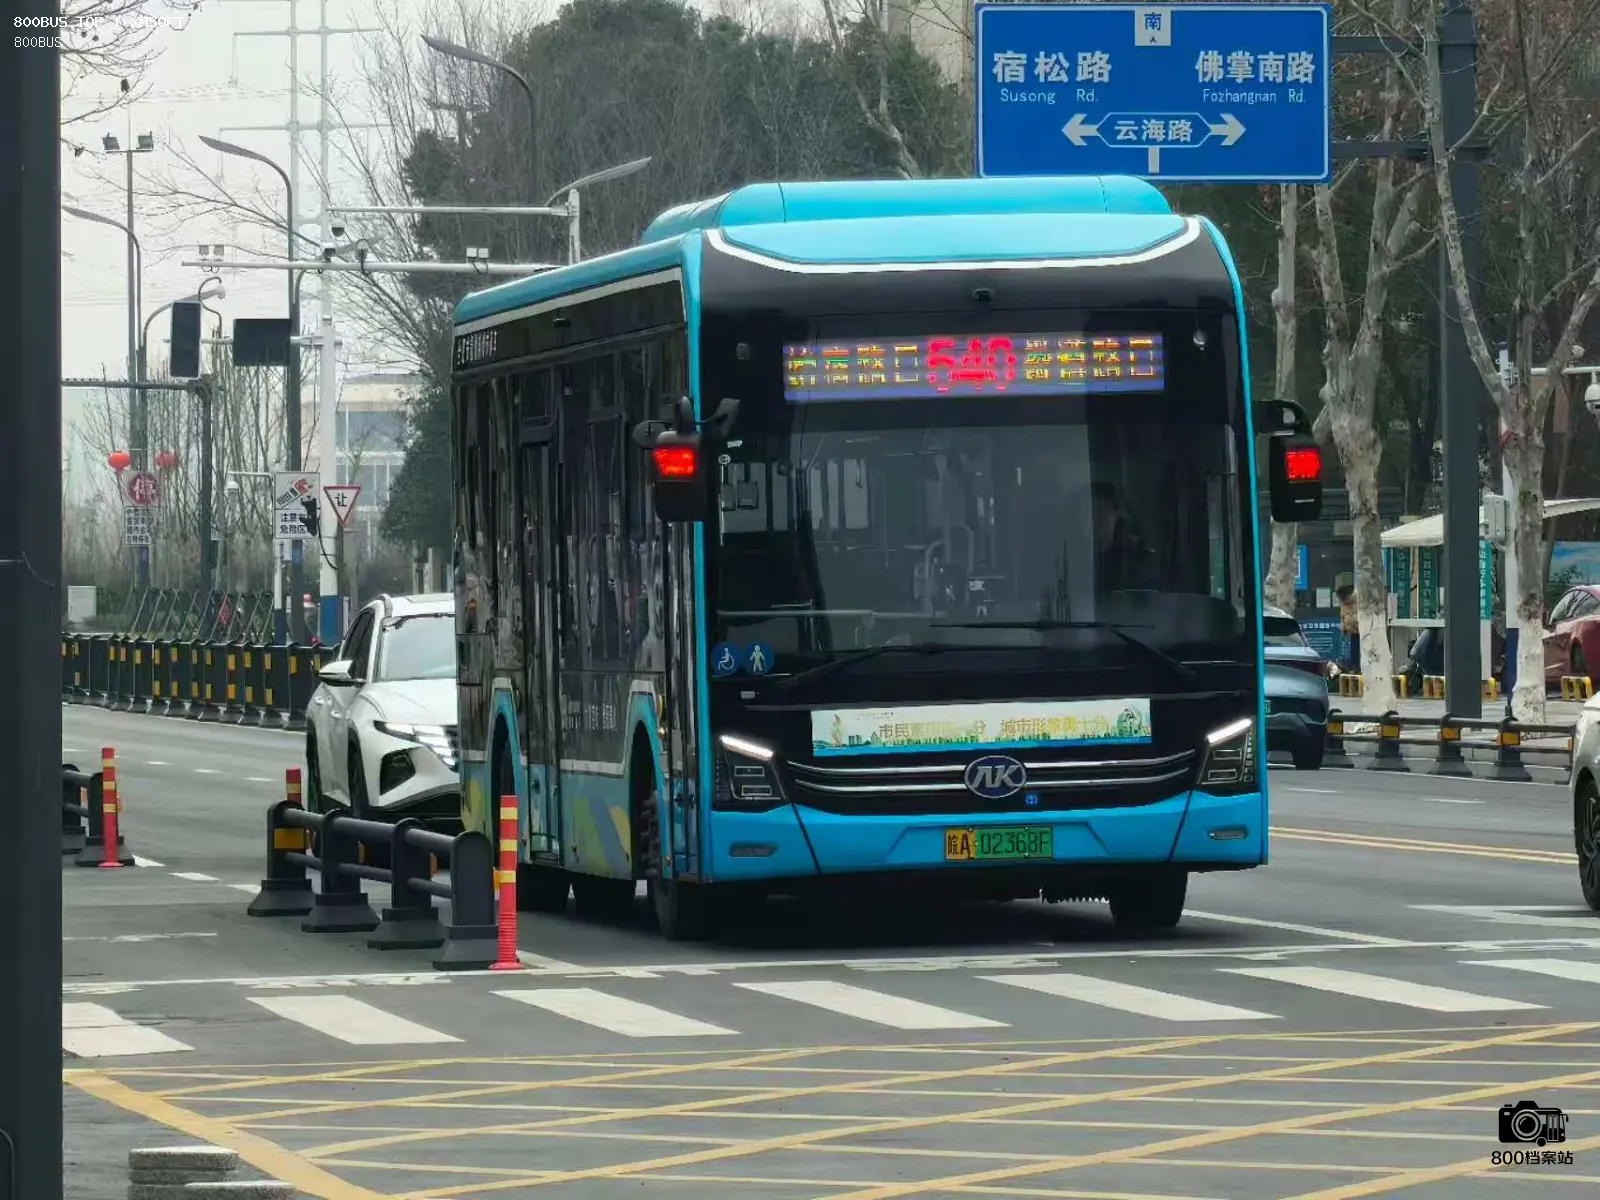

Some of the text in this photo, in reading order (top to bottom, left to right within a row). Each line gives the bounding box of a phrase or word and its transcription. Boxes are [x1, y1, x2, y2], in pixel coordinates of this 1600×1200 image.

[1144, 12, 1162, 30] 南
[992, 51, 1112, 83] 宿松路
[1195, 51, 1315, 83] 佛掌南路
[1000, 88, 1099, 104] Susong Rd.
[1203, 88, 1276, 104] Fozhangnan
[1114, 119, 1193, 142] 云海路
[926, 337, 1016, 392] 540
[334, 493, 347, 507] 让
